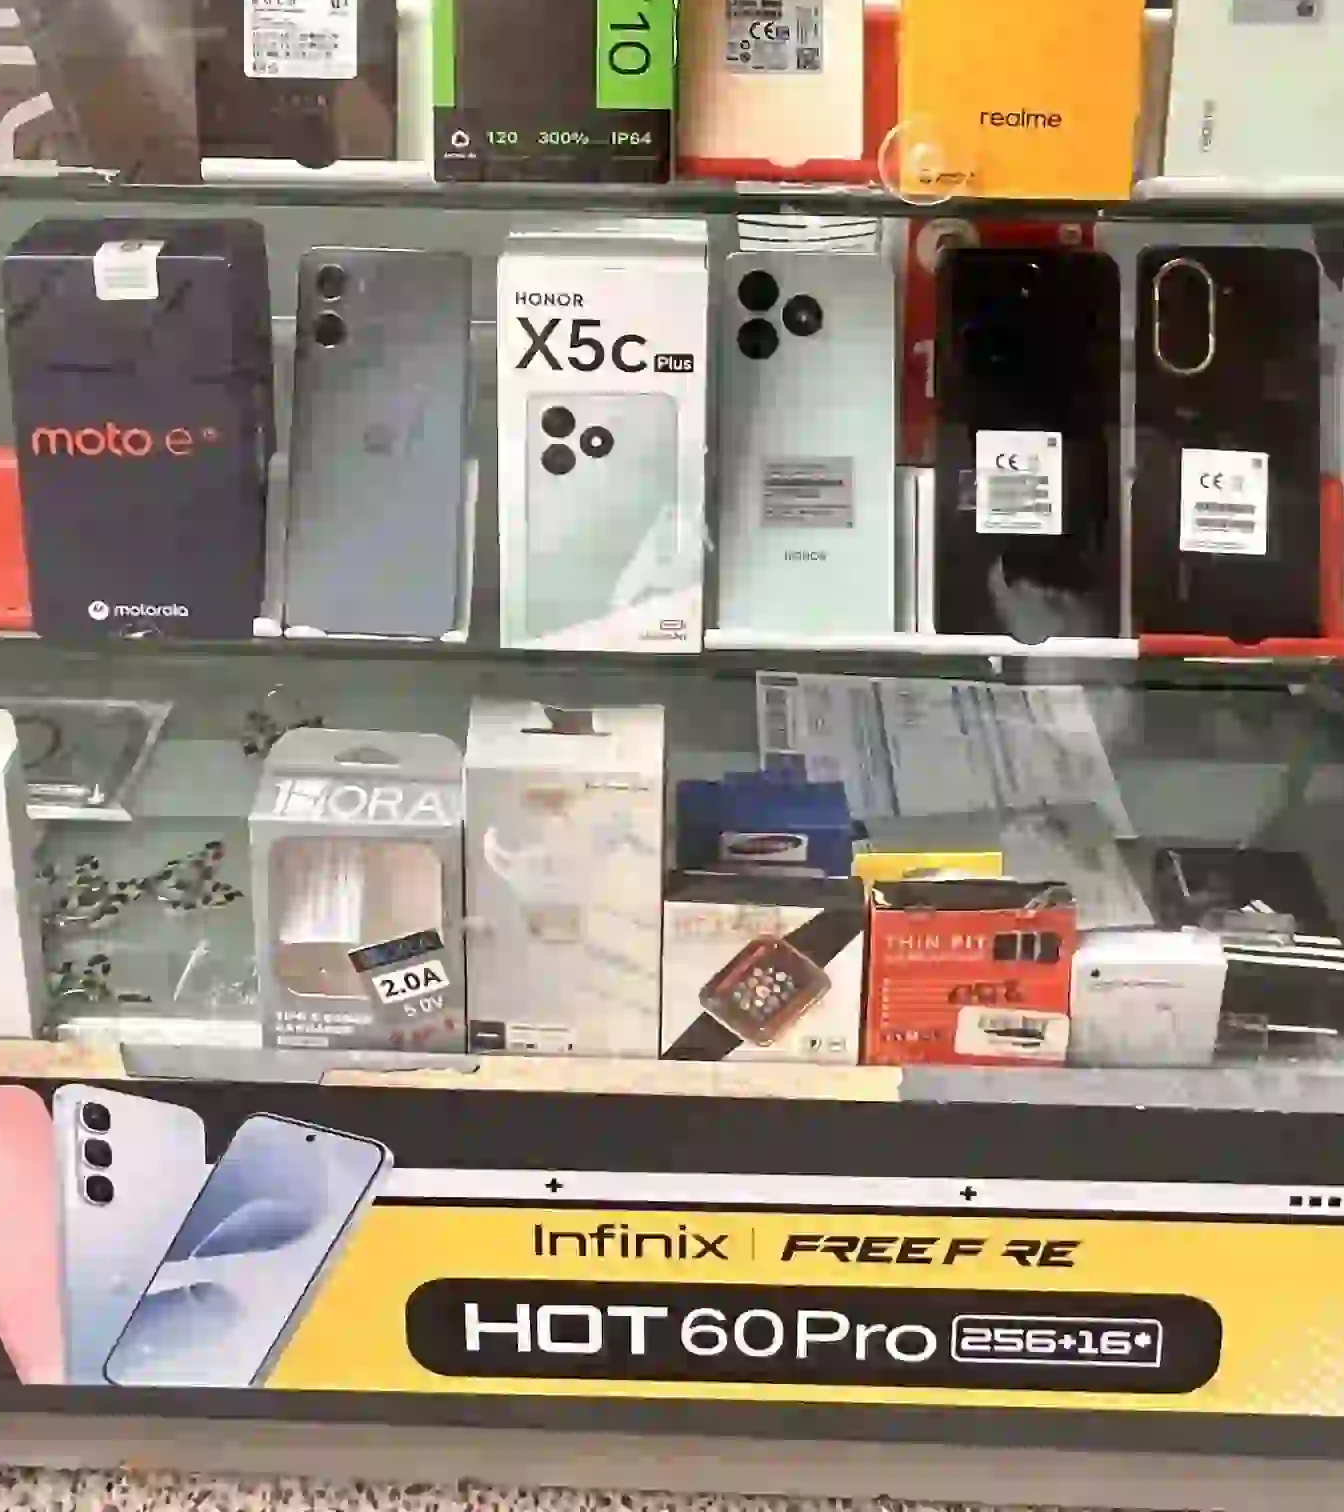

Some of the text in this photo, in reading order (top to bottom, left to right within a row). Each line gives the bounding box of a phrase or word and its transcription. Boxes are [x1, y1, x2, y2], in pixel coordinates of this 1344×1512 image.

[607, 11, 653, 77] 10
[978, 105, 1063, 130] realme
[514, 291, 585, 308] HONOR
[514, 316, 693, 374] X5c Plus
[31, 421, 153, 458] moto
[113, 603, 190, 618] motorola
[379, 966, 443, 998] 2.0A
[532, 1223, 729, 1261] Infinix
[463, 1302, 669, 1355] HOT
